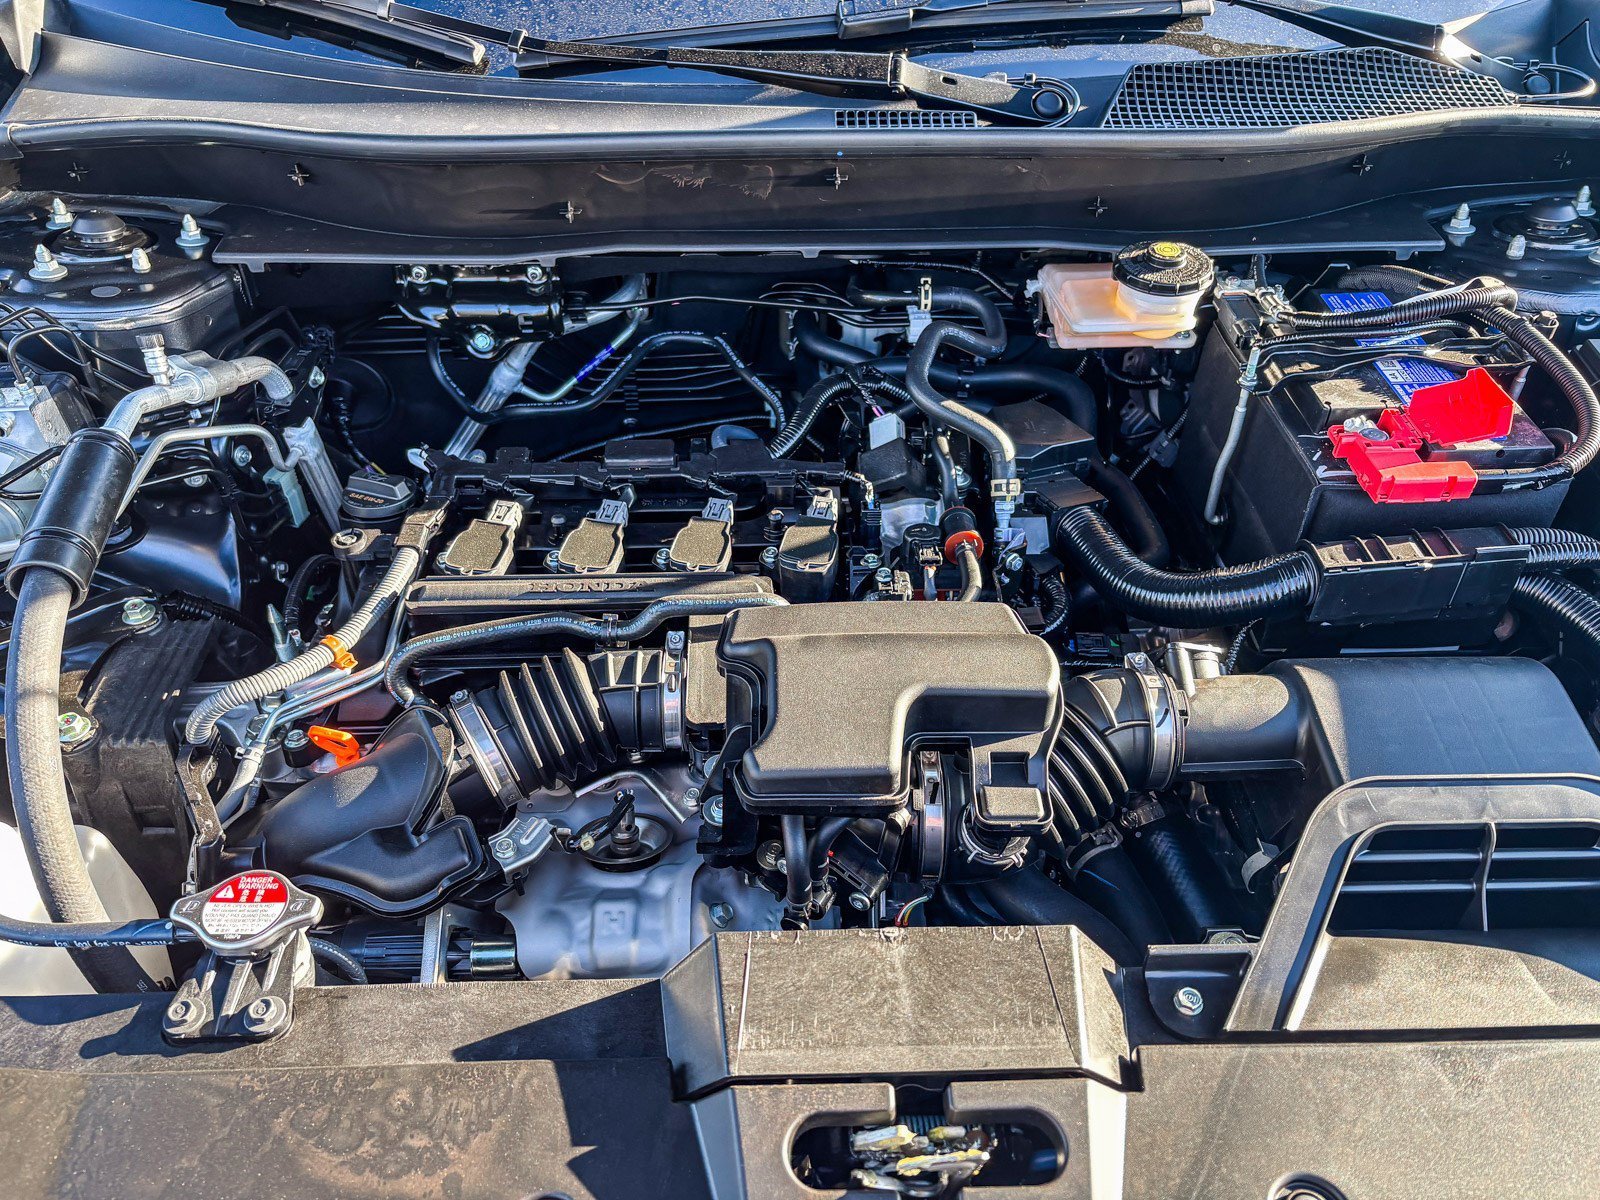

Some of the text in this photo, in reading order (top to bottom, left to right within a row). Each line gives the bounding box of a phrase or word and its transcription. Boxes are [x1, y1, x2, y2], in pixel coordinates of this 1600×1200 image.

[527, 581, 656, 593] HONDA
[494, 622, 524, 631] YAMASHITA
[238, 882, 279, 890] WARNUNG
